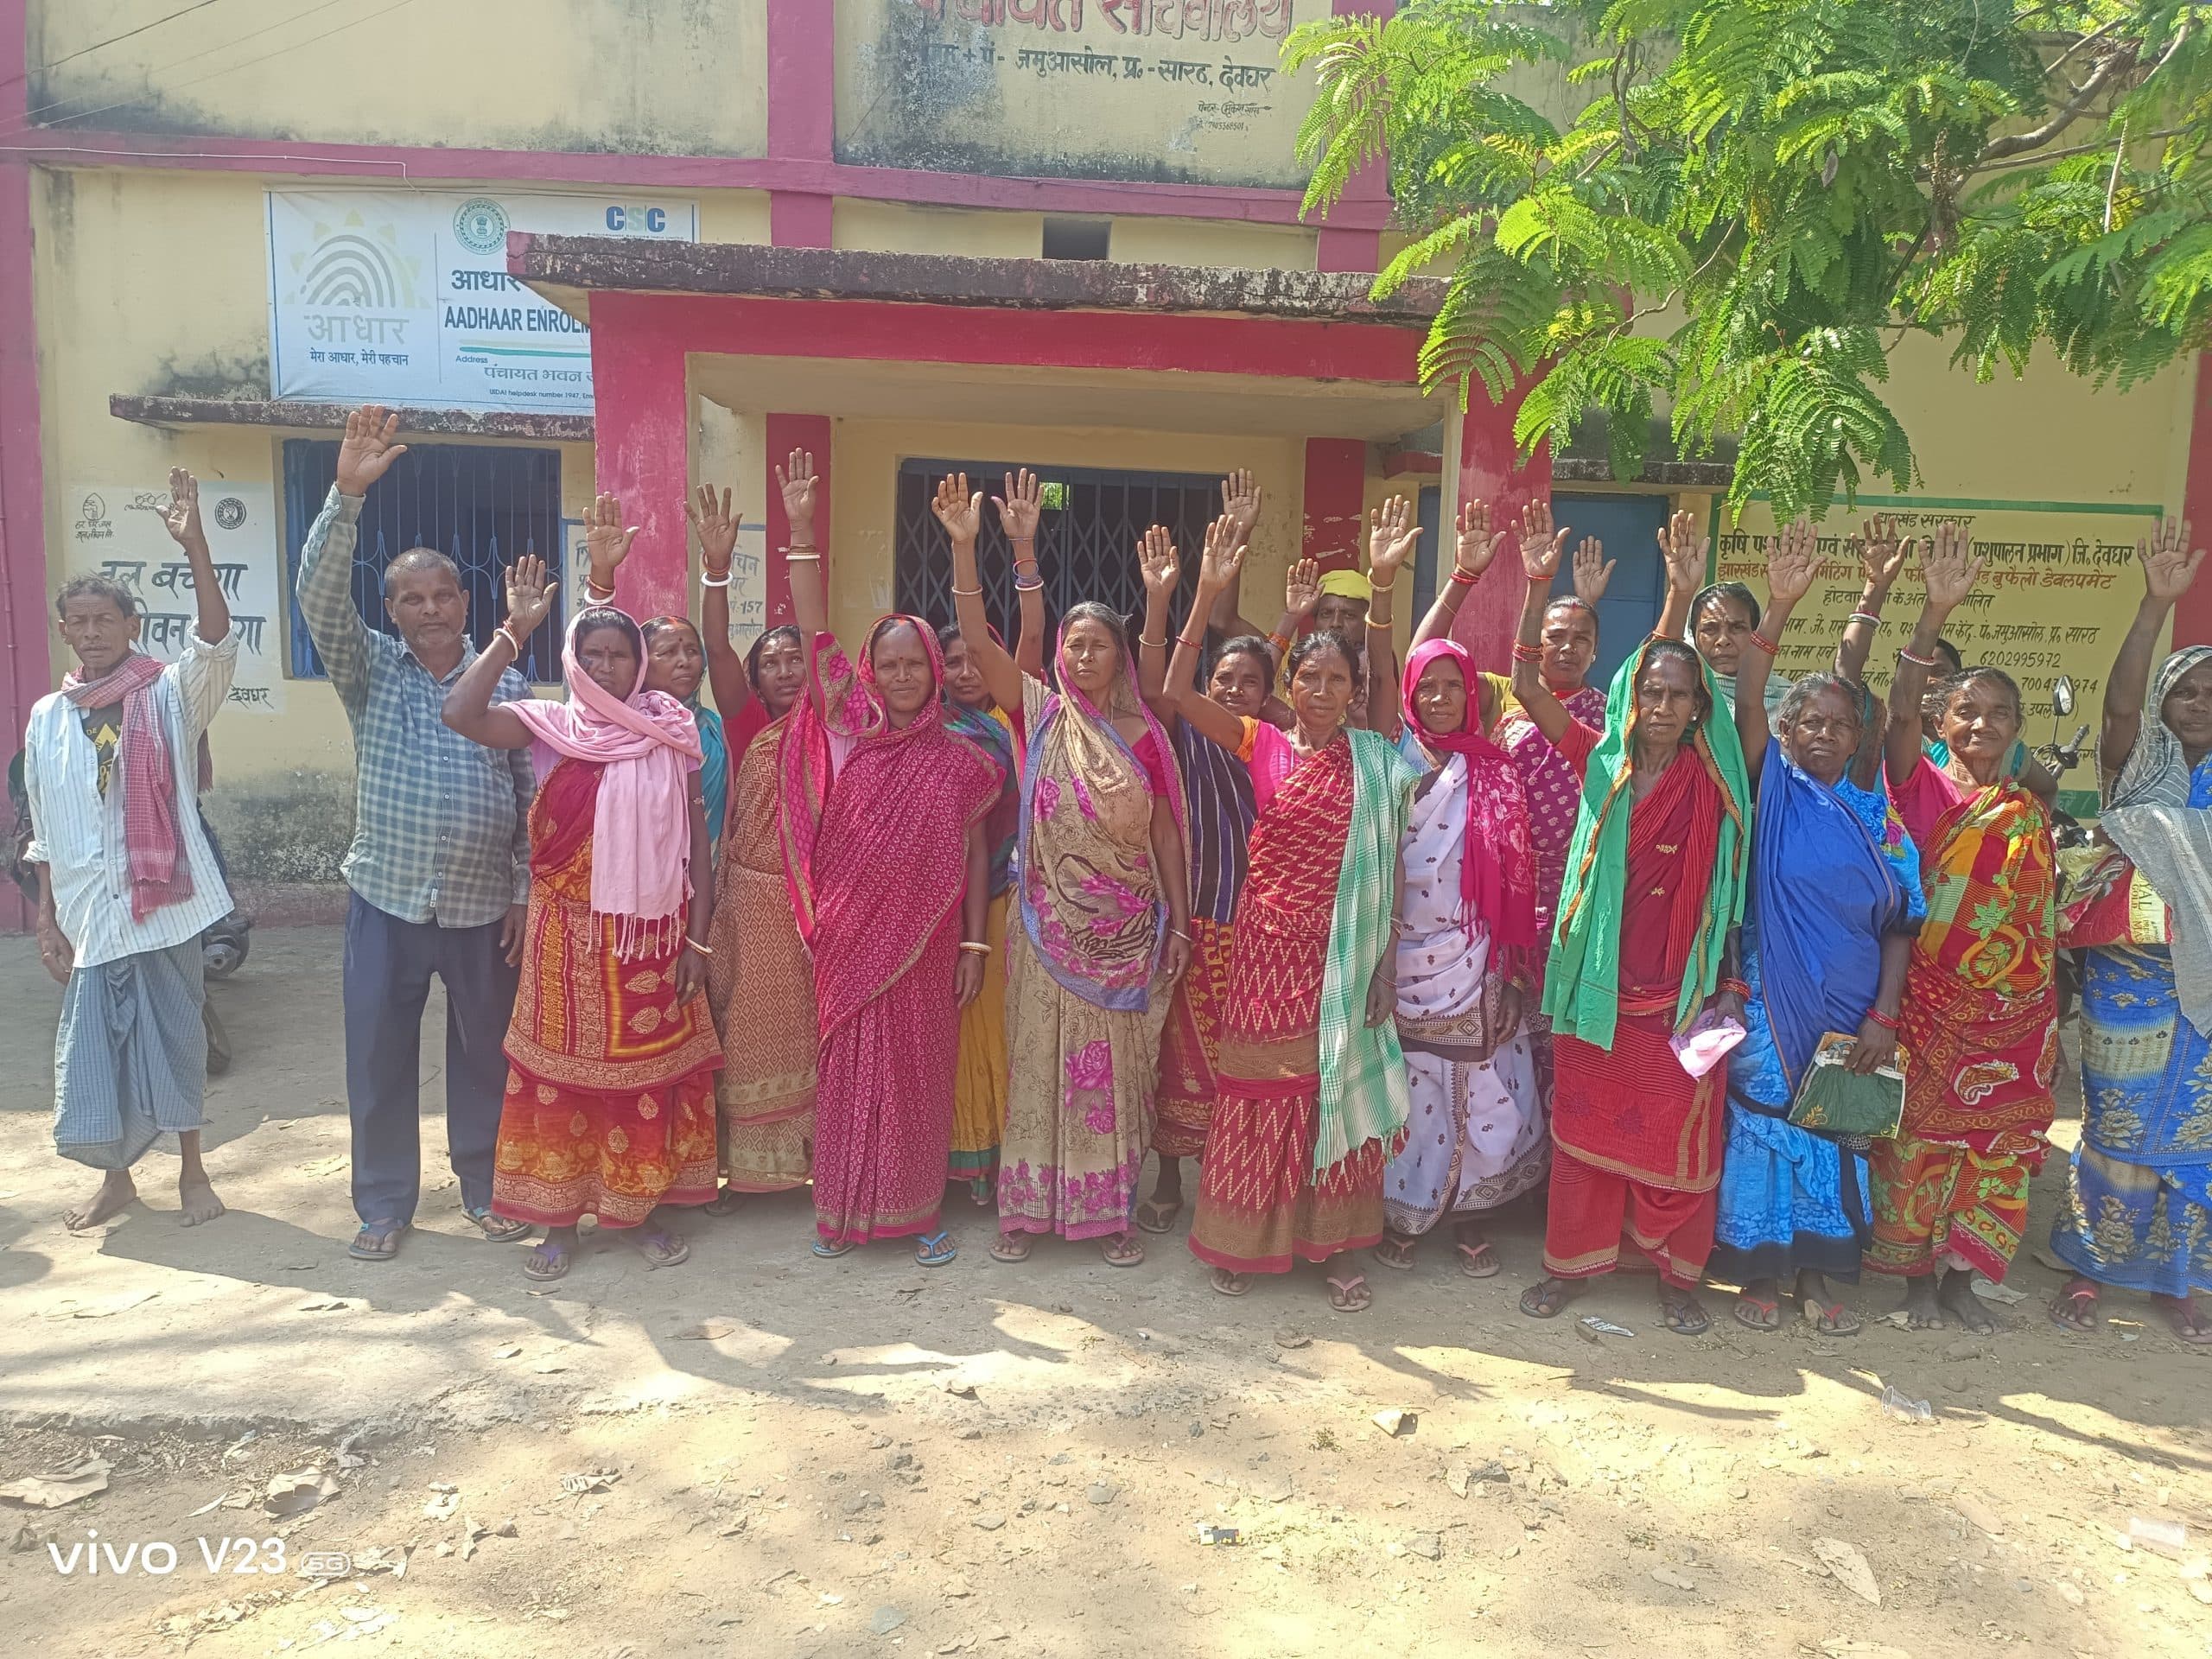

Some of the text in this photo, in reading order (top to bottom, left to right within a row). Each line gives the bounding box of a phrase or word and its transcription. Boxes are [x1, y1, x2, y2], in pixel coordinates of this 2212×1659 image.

[1219, 55, 1276, 93] देवघर
[607, 206, 665, 232] CSC
[451, 270, 521, 292] आधार
[304, 314, 410, 345] आधार
[444, 306, 523, 331] AADHAAR
[310, 347, 325, 363] मेरा
[361, 348, 376, 365] मेरी
[378, 353, 409, 365] पहचान
[455, 355, 488, 364] Address
[484, 364, 537, 381] पंचायत
[543, 370, 582, 382] भवन
[2092, 539, 2135, 568] देवघर
[2066, 626, 2101, 645] सारठ
[1980, 650, 2061, 668] 6202995972
